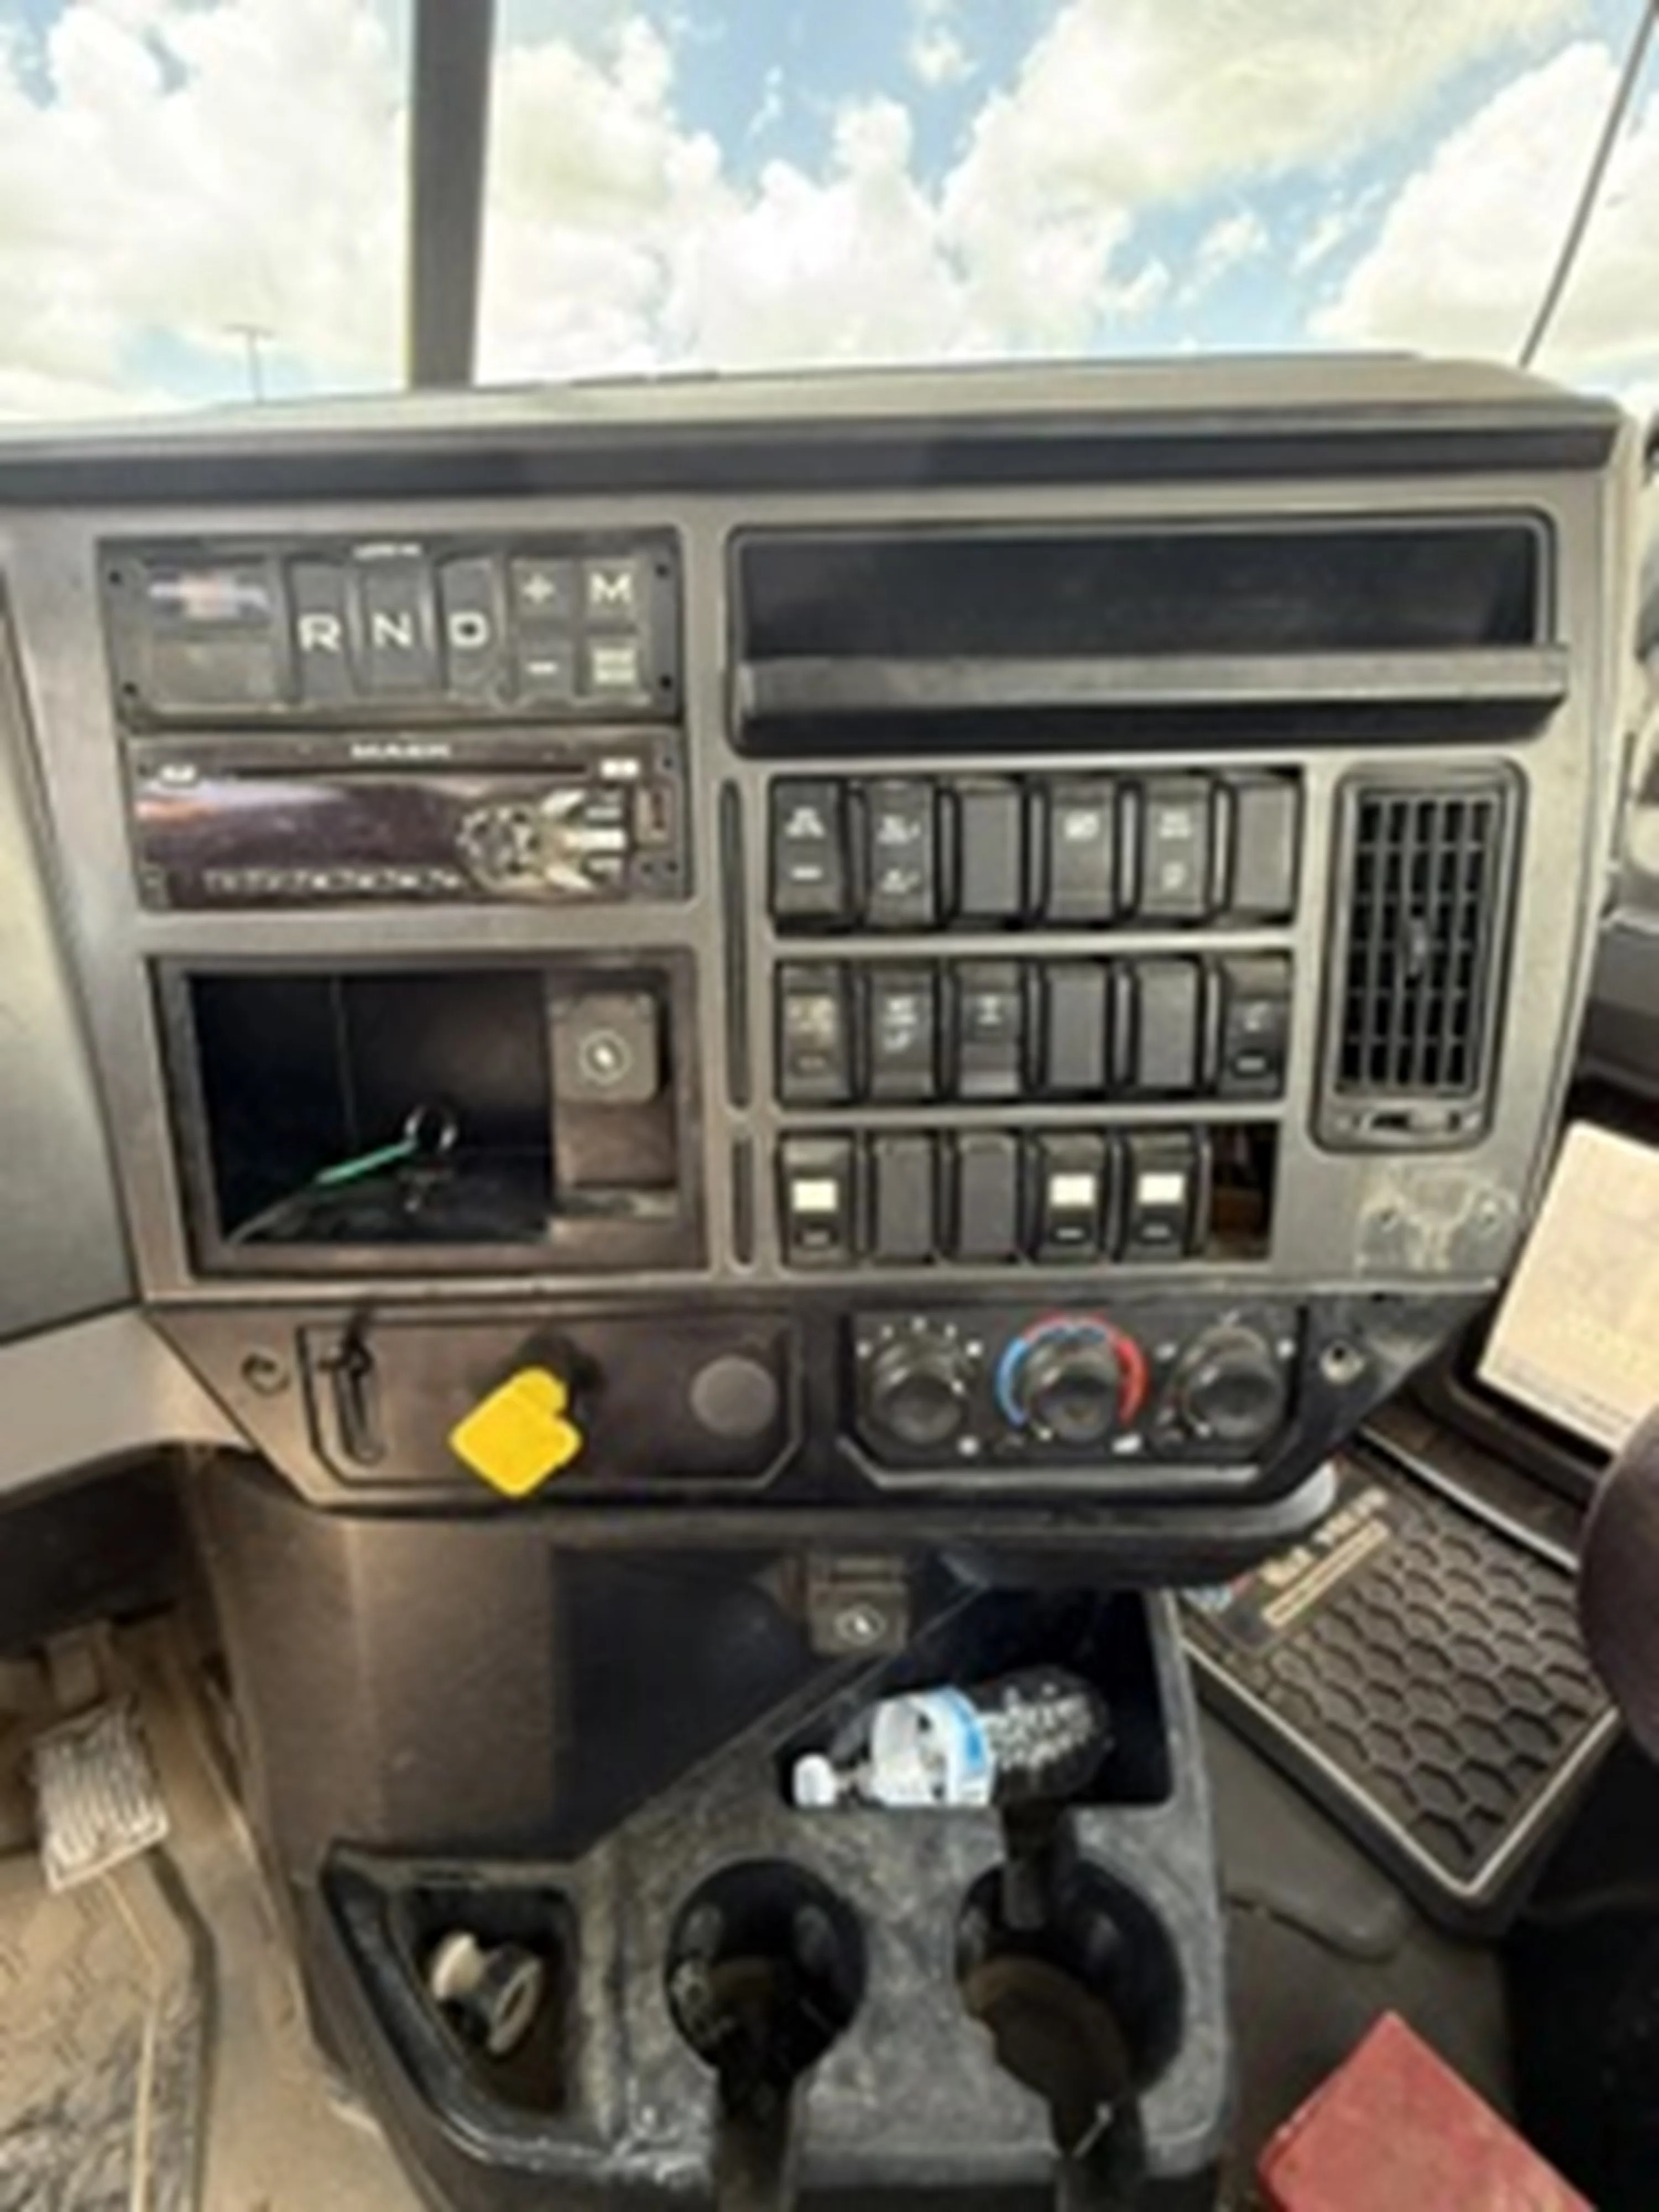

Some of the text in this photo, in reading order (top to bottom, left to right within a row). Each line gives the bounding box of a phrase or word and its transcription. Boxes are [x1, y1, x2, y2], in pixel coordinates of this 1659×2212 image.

[589, 572, 633, 603] M
[298, 611, 488, 651] R N D
